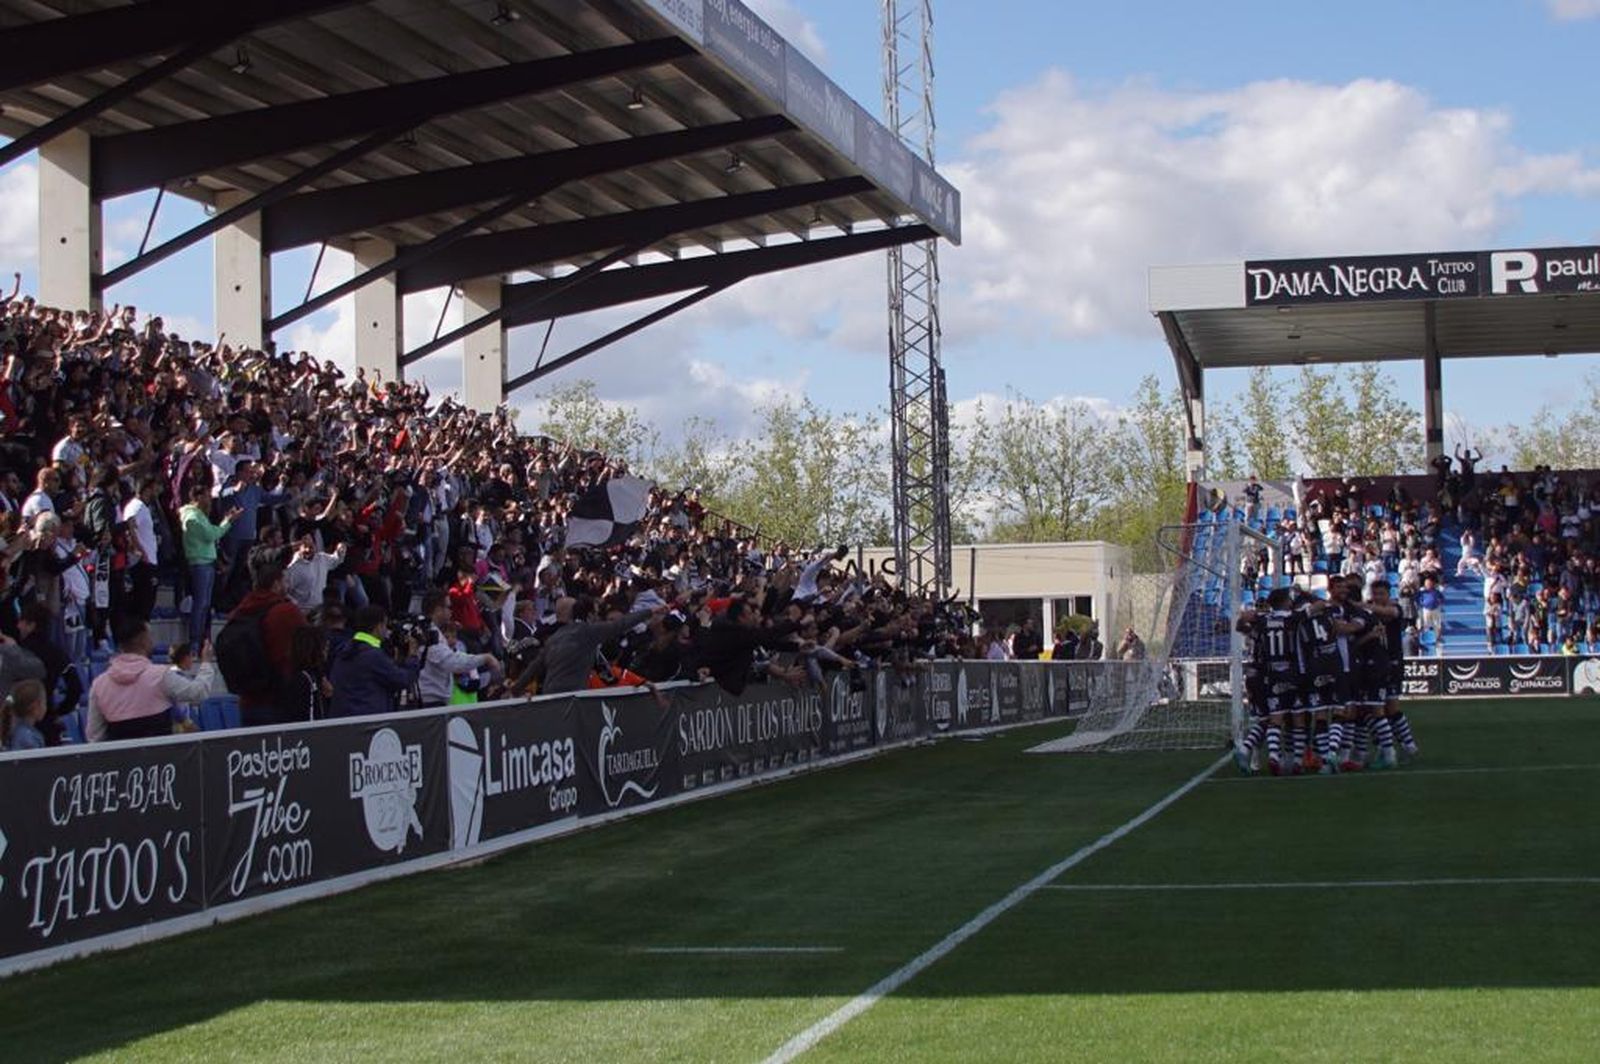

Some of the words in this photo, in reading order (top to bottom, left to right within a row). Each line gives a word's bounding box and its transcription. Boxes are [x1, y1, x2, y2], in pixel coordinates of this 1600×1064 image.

[1248, 268, 1332, 301] DAMA
[1330, 264, 1429, 297] NEGRA
[1427, 259, 1475, 275] TATTOO
[1490, 251, 1538, 294] R
[1437, 278, 1466, 294] CLUB
[1267, 629, 1284, 656] 11
[1311, 618, 1329, 642] 4
[1448, 680, 1500, 693] GUINALDO
[678, 694, 734, 757] SARDÓN
[737, 703, 754, 744] DE
[757, 699, 779, 742] LOS
[351, 750, 420, 793] BROCENSE
[484, 727, 576, 796] Limcasa
[49, 763, 181, 826] CAFE-BAR
[550, 786, 577, 812] Grupo
